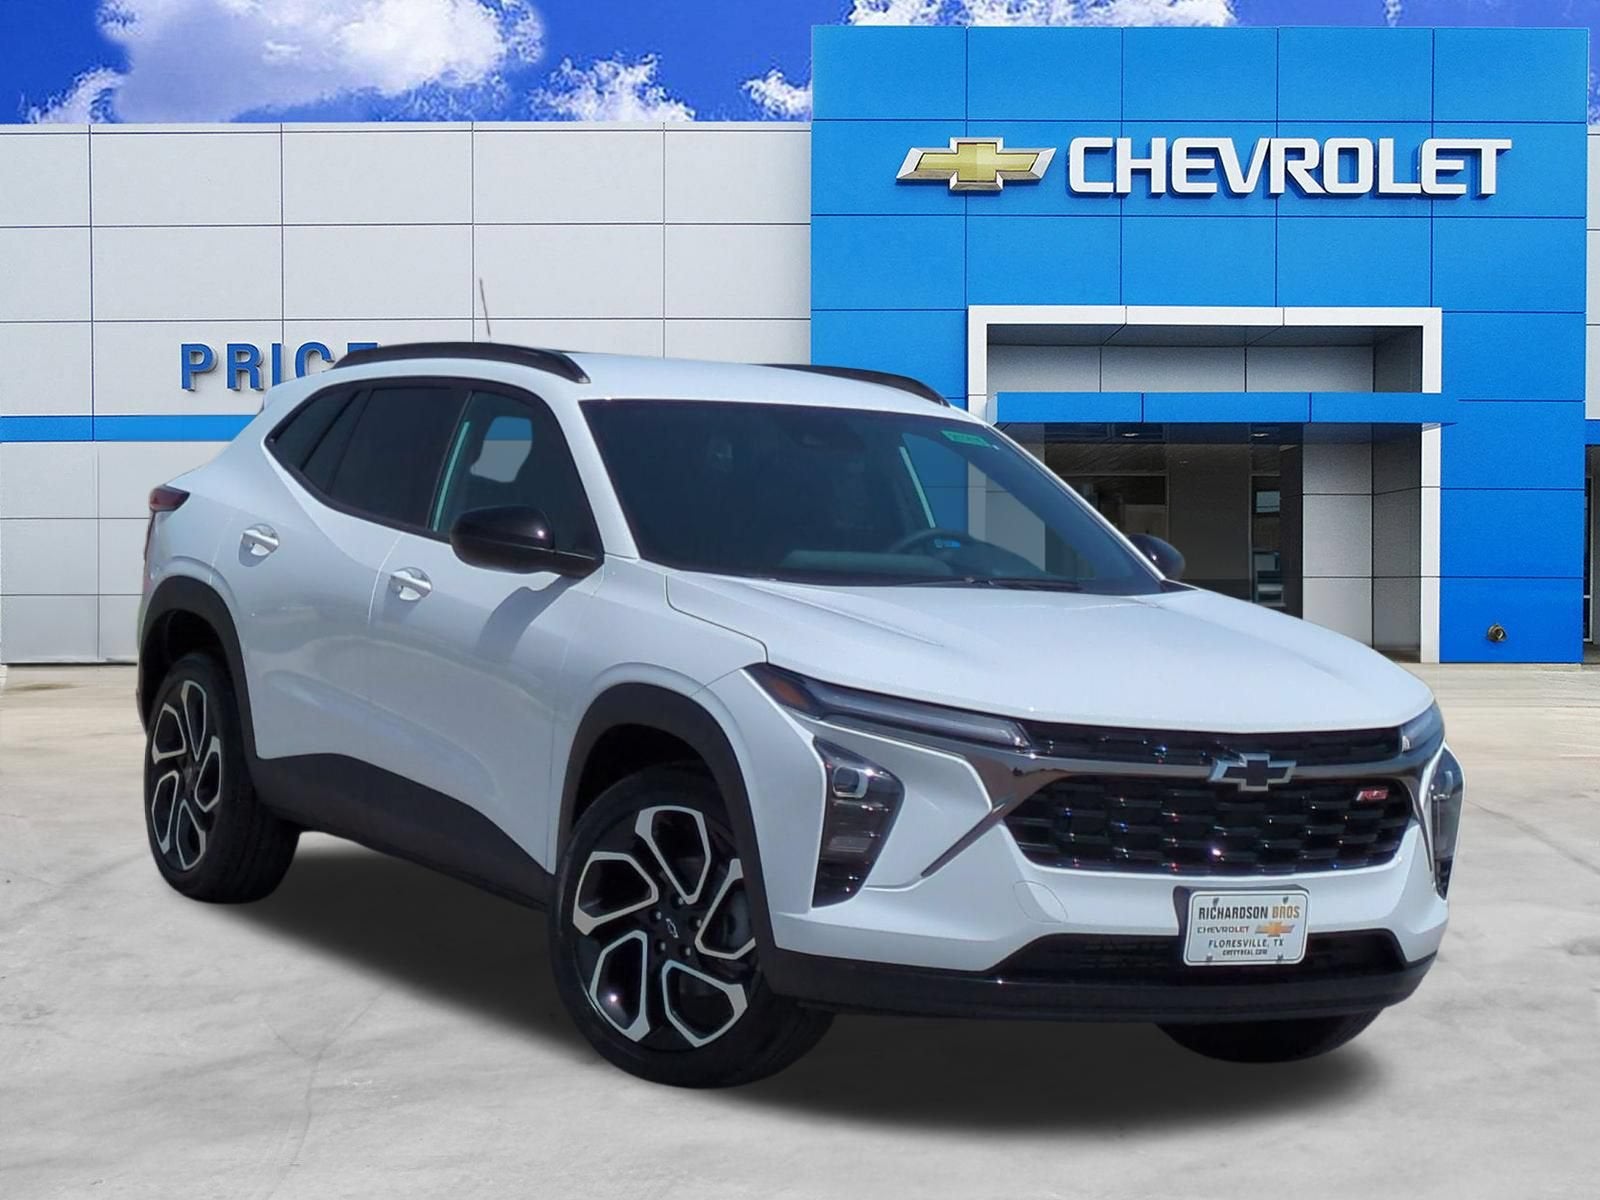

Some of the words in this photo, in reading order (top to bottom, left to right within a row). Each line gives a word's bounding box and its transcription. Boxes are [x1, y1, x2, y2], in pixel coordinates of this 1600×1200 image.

[1068, 137, 1512, 195] CHEVROLET
[180, 341, 379, 391] PRIC
[1198, 906, 1269, 920] RICHARDSON
[1272, 905, 1300, 919] BROS
[1196, 925, 1250, 934] CHEVROLET
[1273, 938, 1284, 946] TX
